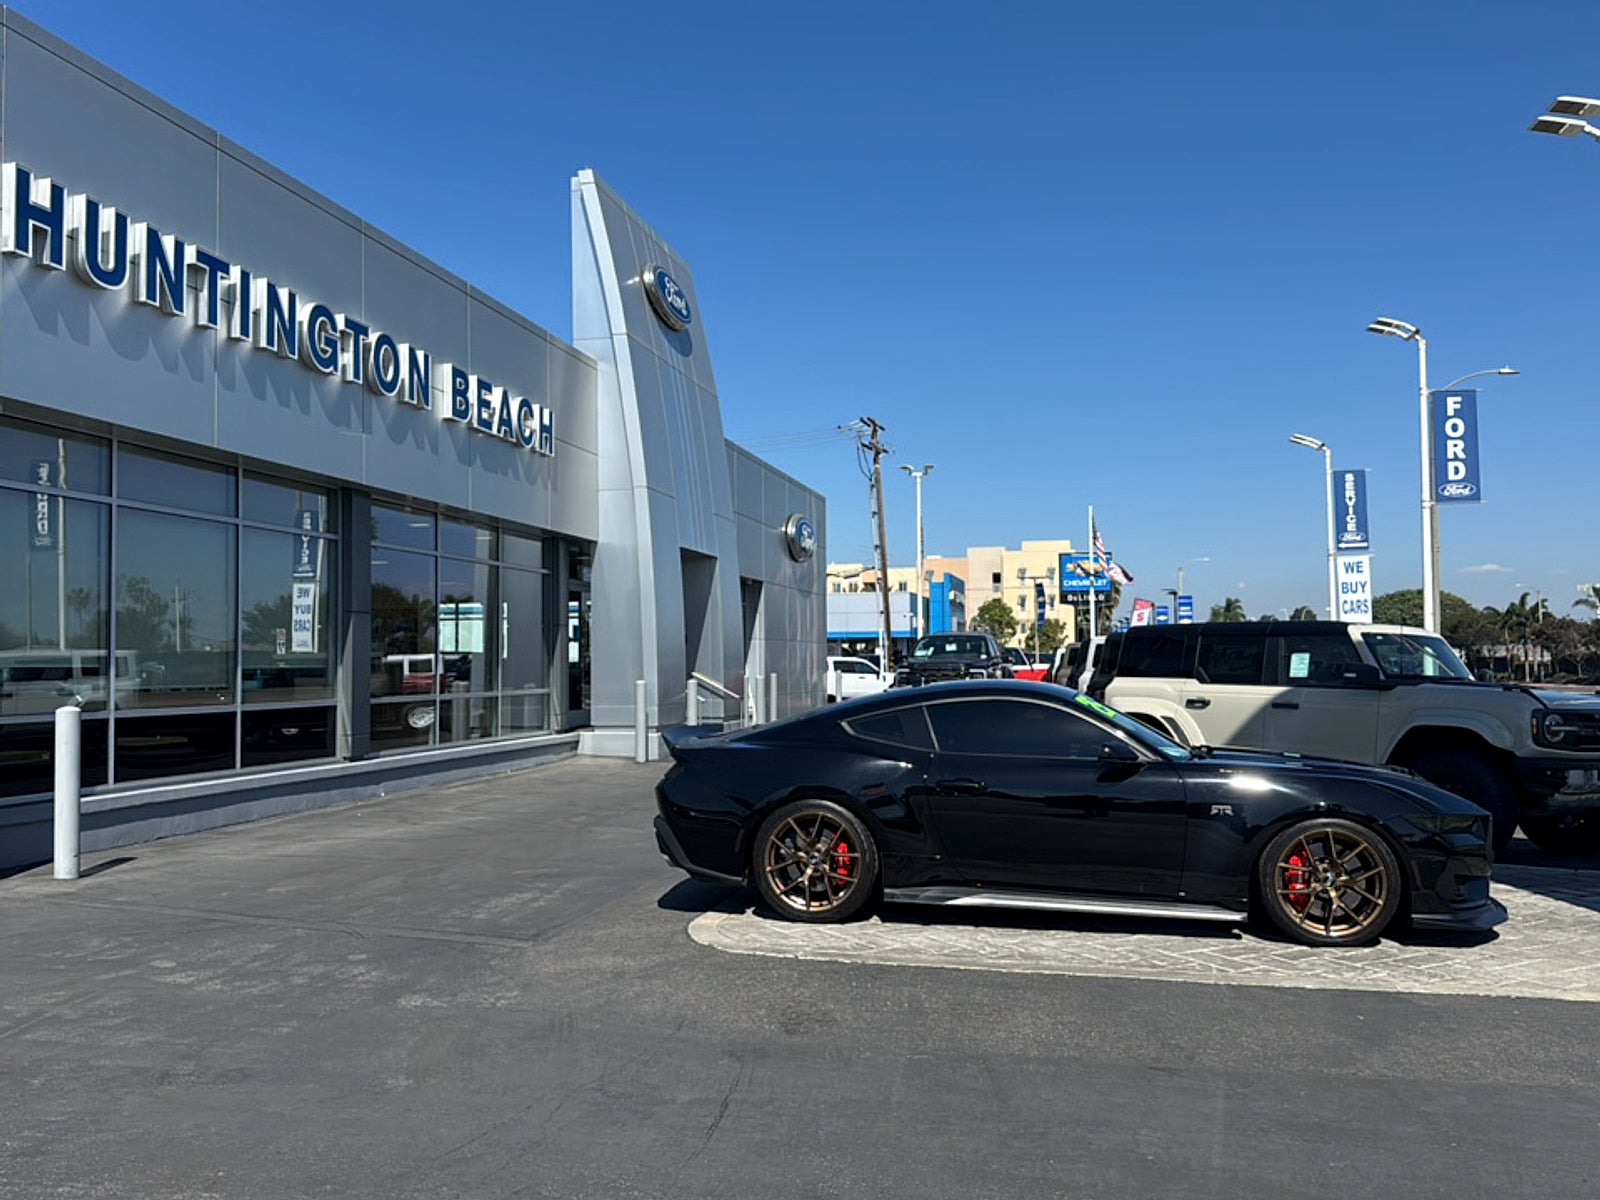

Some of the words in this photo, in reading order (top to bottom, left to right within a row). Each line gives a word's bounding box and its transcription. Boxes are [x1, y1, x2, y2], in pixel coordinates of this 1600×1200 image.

[3, 162, 432, 412] HUNTINGTON
[443, 363, 555, 457] BEACH
[1445, 396, 1467, 481] FORD
[1443, 483, 1472, 496] Ford
[1344, 473, 1357, 531] SERVICE
[1343, 561, 1364, 574] WE
[1341, 581, 1368, 595] BUY
[1342, 599, 1369, 615] CARS
